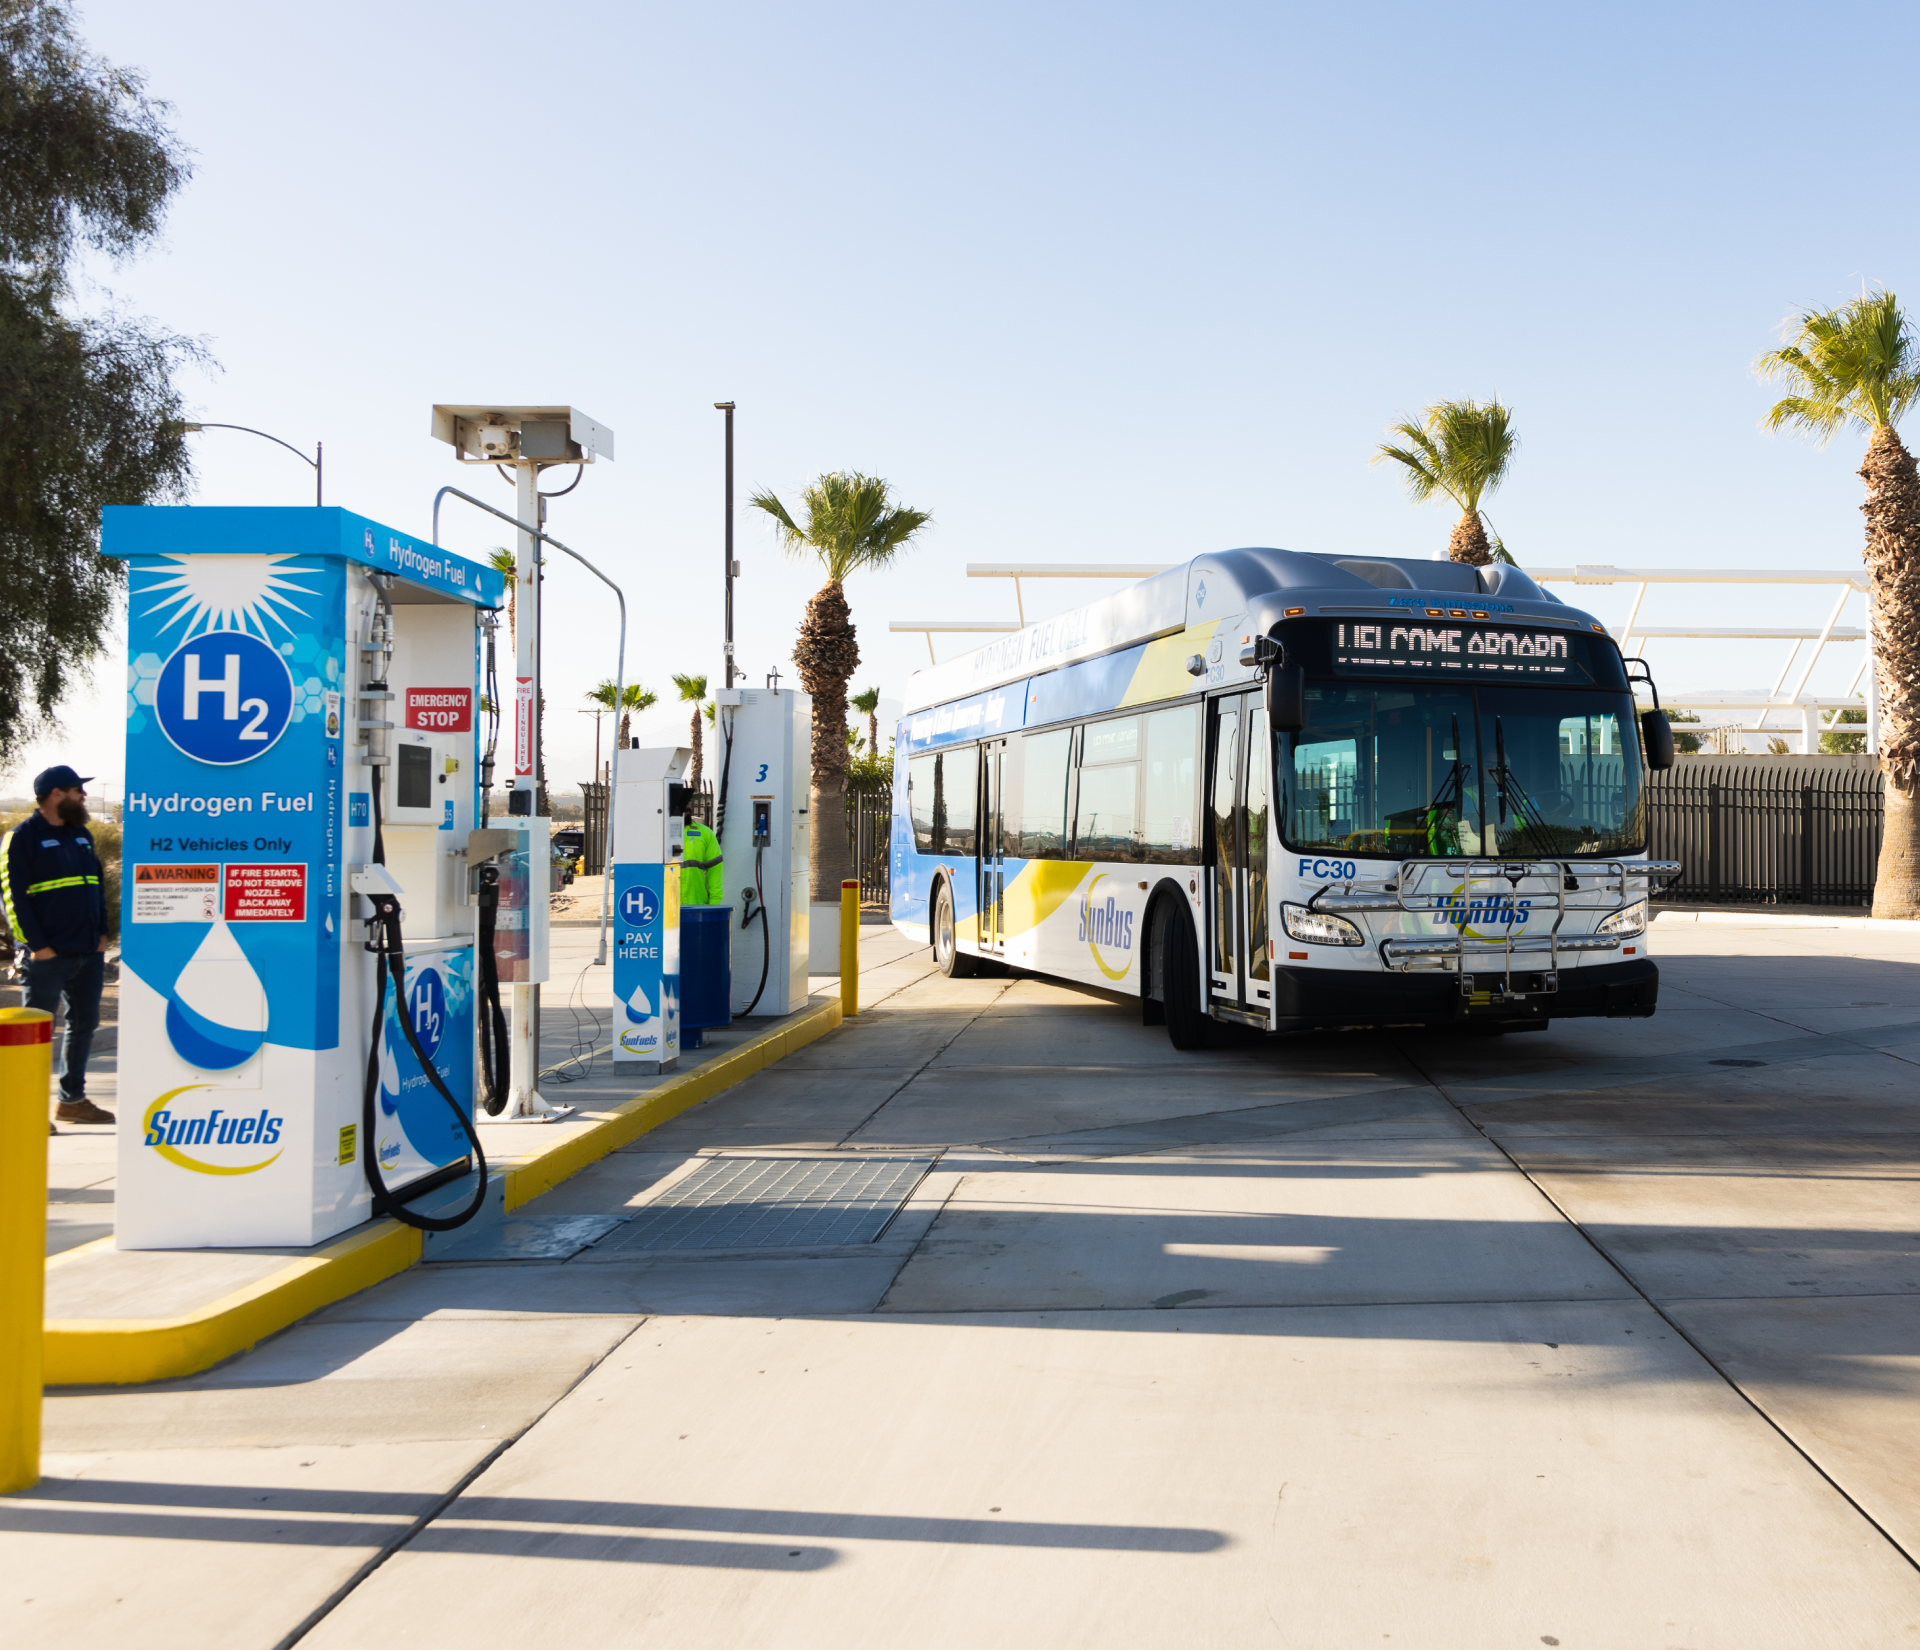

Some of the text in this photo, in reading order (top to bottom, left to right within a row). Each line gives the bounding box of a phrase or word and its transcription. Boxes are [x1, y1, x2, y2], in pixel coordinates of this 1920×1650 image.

[365, 532, 466, 587] H2 Hydrogen Fuel
[1388, 595, 1514, 613] Zero Emissions
[1028, 621, 1056, 664] FUEL
[1205, 663, 1225, 684] FC30
[183, 654, 269, 740] H2
[410, 694, 468, 707] EMERGENCY
[417, 711, 459, 727] STOP
[328, 748, 337, 765] H2
[755, 763, 769, 783] 3
[129, 792, 313, 818] Hydrogen Fuel
[351, 802, 367, 817] H70
[150, 837, 292, 854] H2 Vehicles Only
[327, 779, 336, 897] Hydrogen Fuel
[154, 868, 216, 880] WARNING
[231, 869, 301, 878] IF FIRE STARTS,
[1299, 859, 1356, 880] FC30
[228, 879, 303, 887] DO NOT REMOVE
[244, 889, 281, 897] NOZZLE
[238, 899, 292, 907] BACK AWAY
[626, 892, 653, 920] H2
[234, 908, 295, 917] IMMEDIATELY
[1079, 893, 1133, 950] SunBus
[625, 932, 653, 944] PAY
[619, 947, 659, 959] HERE
[415, 983, 440, 1043] H2
[620, 1035, 658, 1046] SunFuels
[144, 1108, 285, 1146] SunFuels
